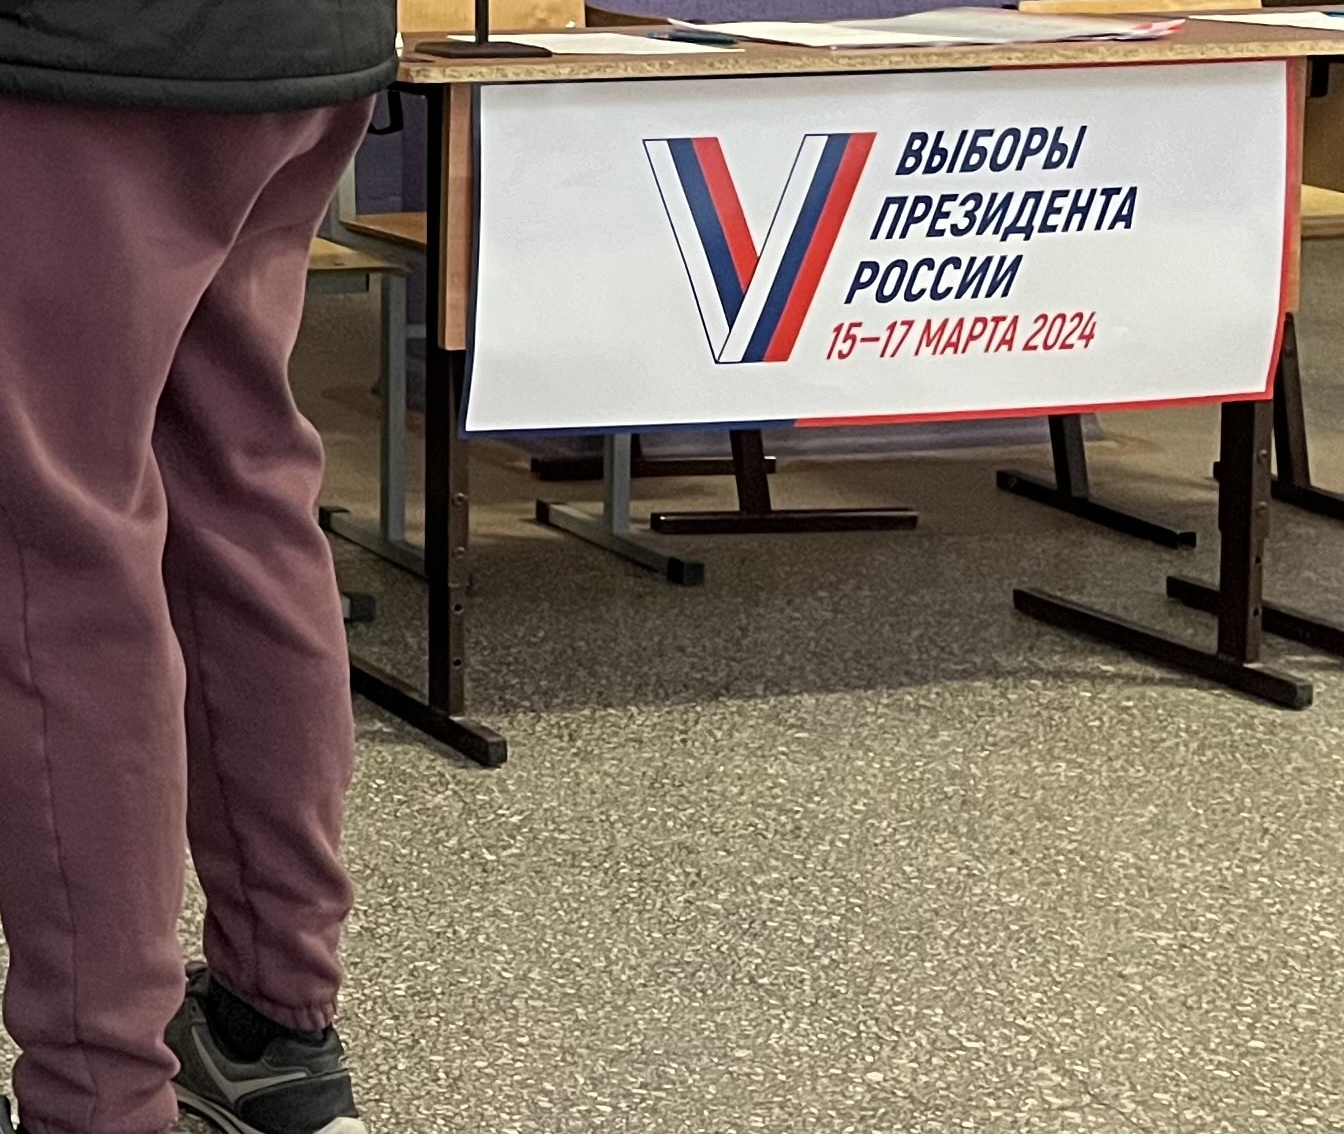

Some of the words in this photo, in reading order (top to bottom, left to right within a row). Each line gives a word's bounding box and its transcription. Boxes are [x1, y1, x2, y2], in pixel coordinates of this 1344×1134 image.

[895, 126, 1088, 175] ВЫБОРЫ
[871, 187, 1138, 241] ПРЕЗИДЕНТА
[845, 255, 1023, 304] РОССИИ
[913, 314, 1021, 358] МАРТА
[1024, 312, 1097, 353] 2024
